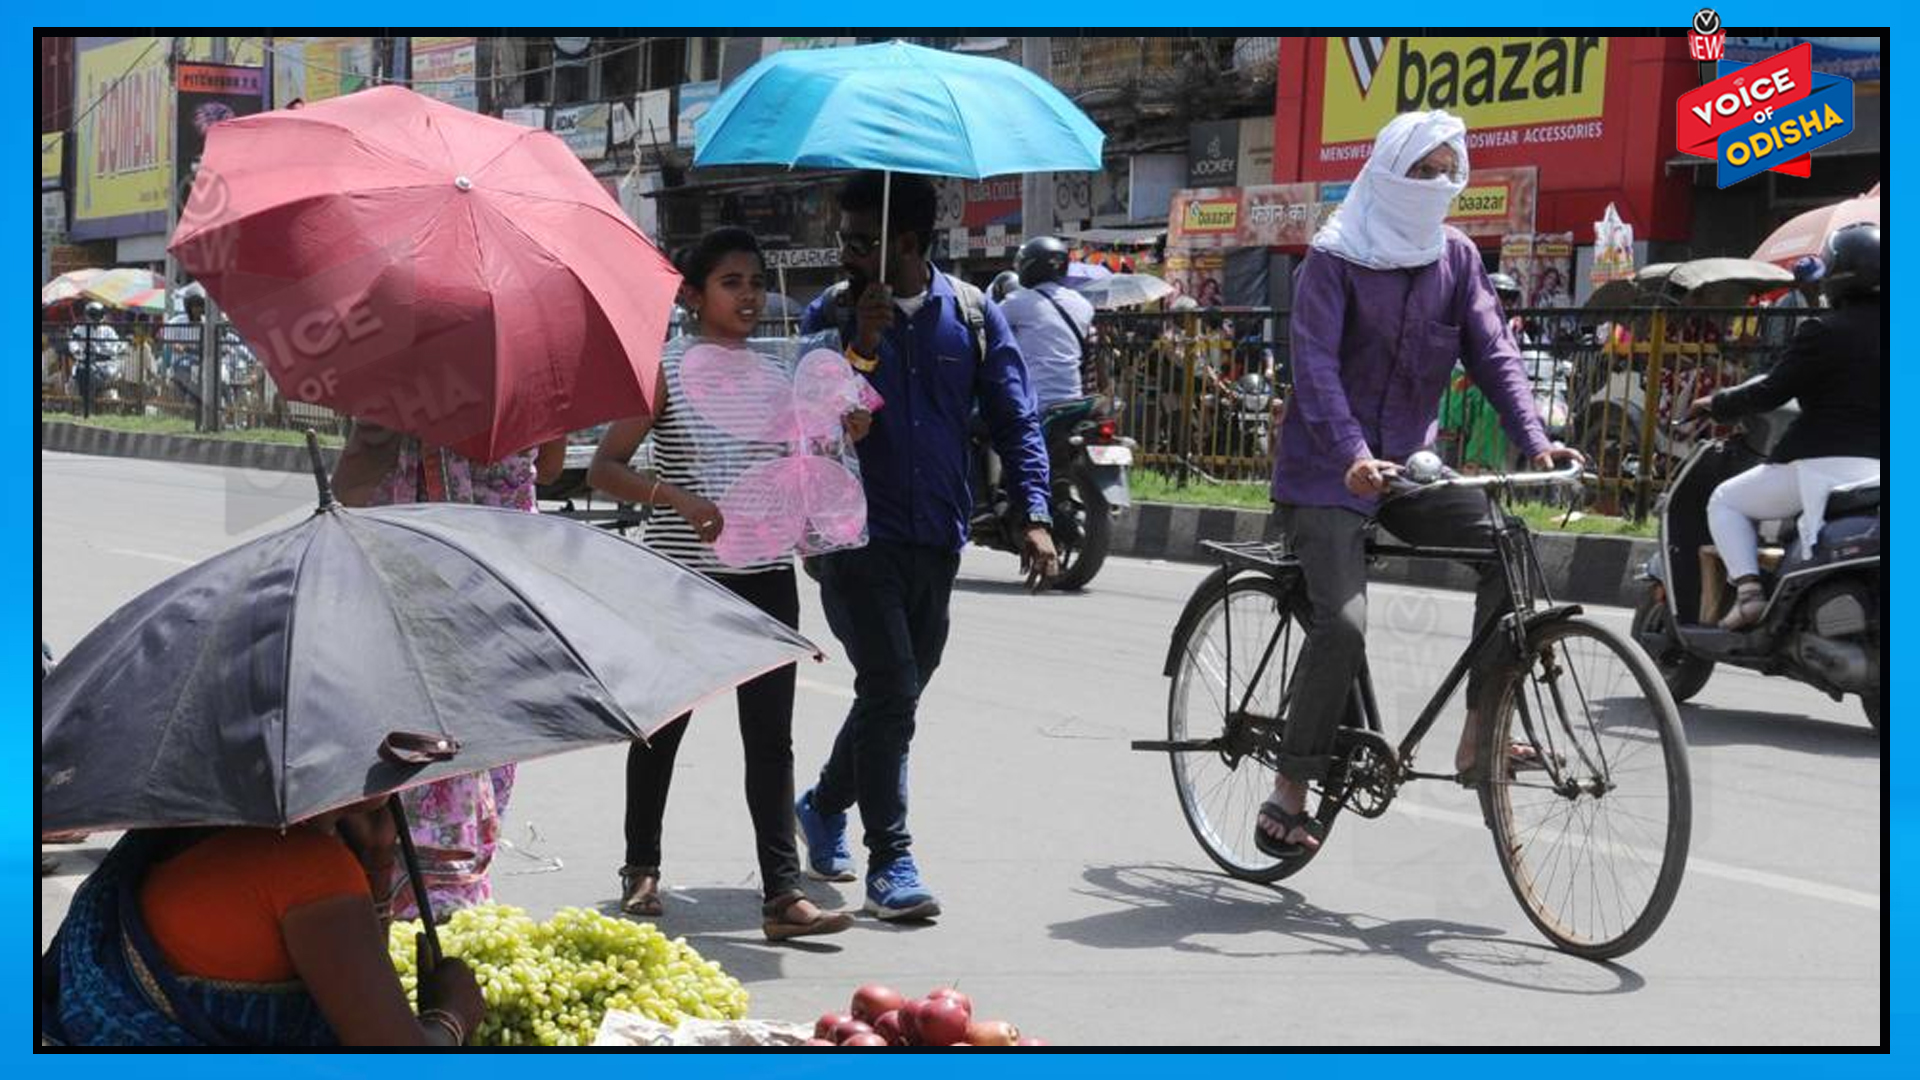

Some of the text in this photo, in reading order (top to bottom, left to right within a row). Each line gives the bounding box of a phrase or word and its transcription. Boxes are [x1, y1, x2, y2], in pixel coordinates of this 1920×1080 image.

[1396, 37, 1601, 113] baazar
[1320, 121, 1603, 161] MENSWEA IDSWEAR ACCESSORIES
[1191, 157, 1236, 175] JOCKEY
